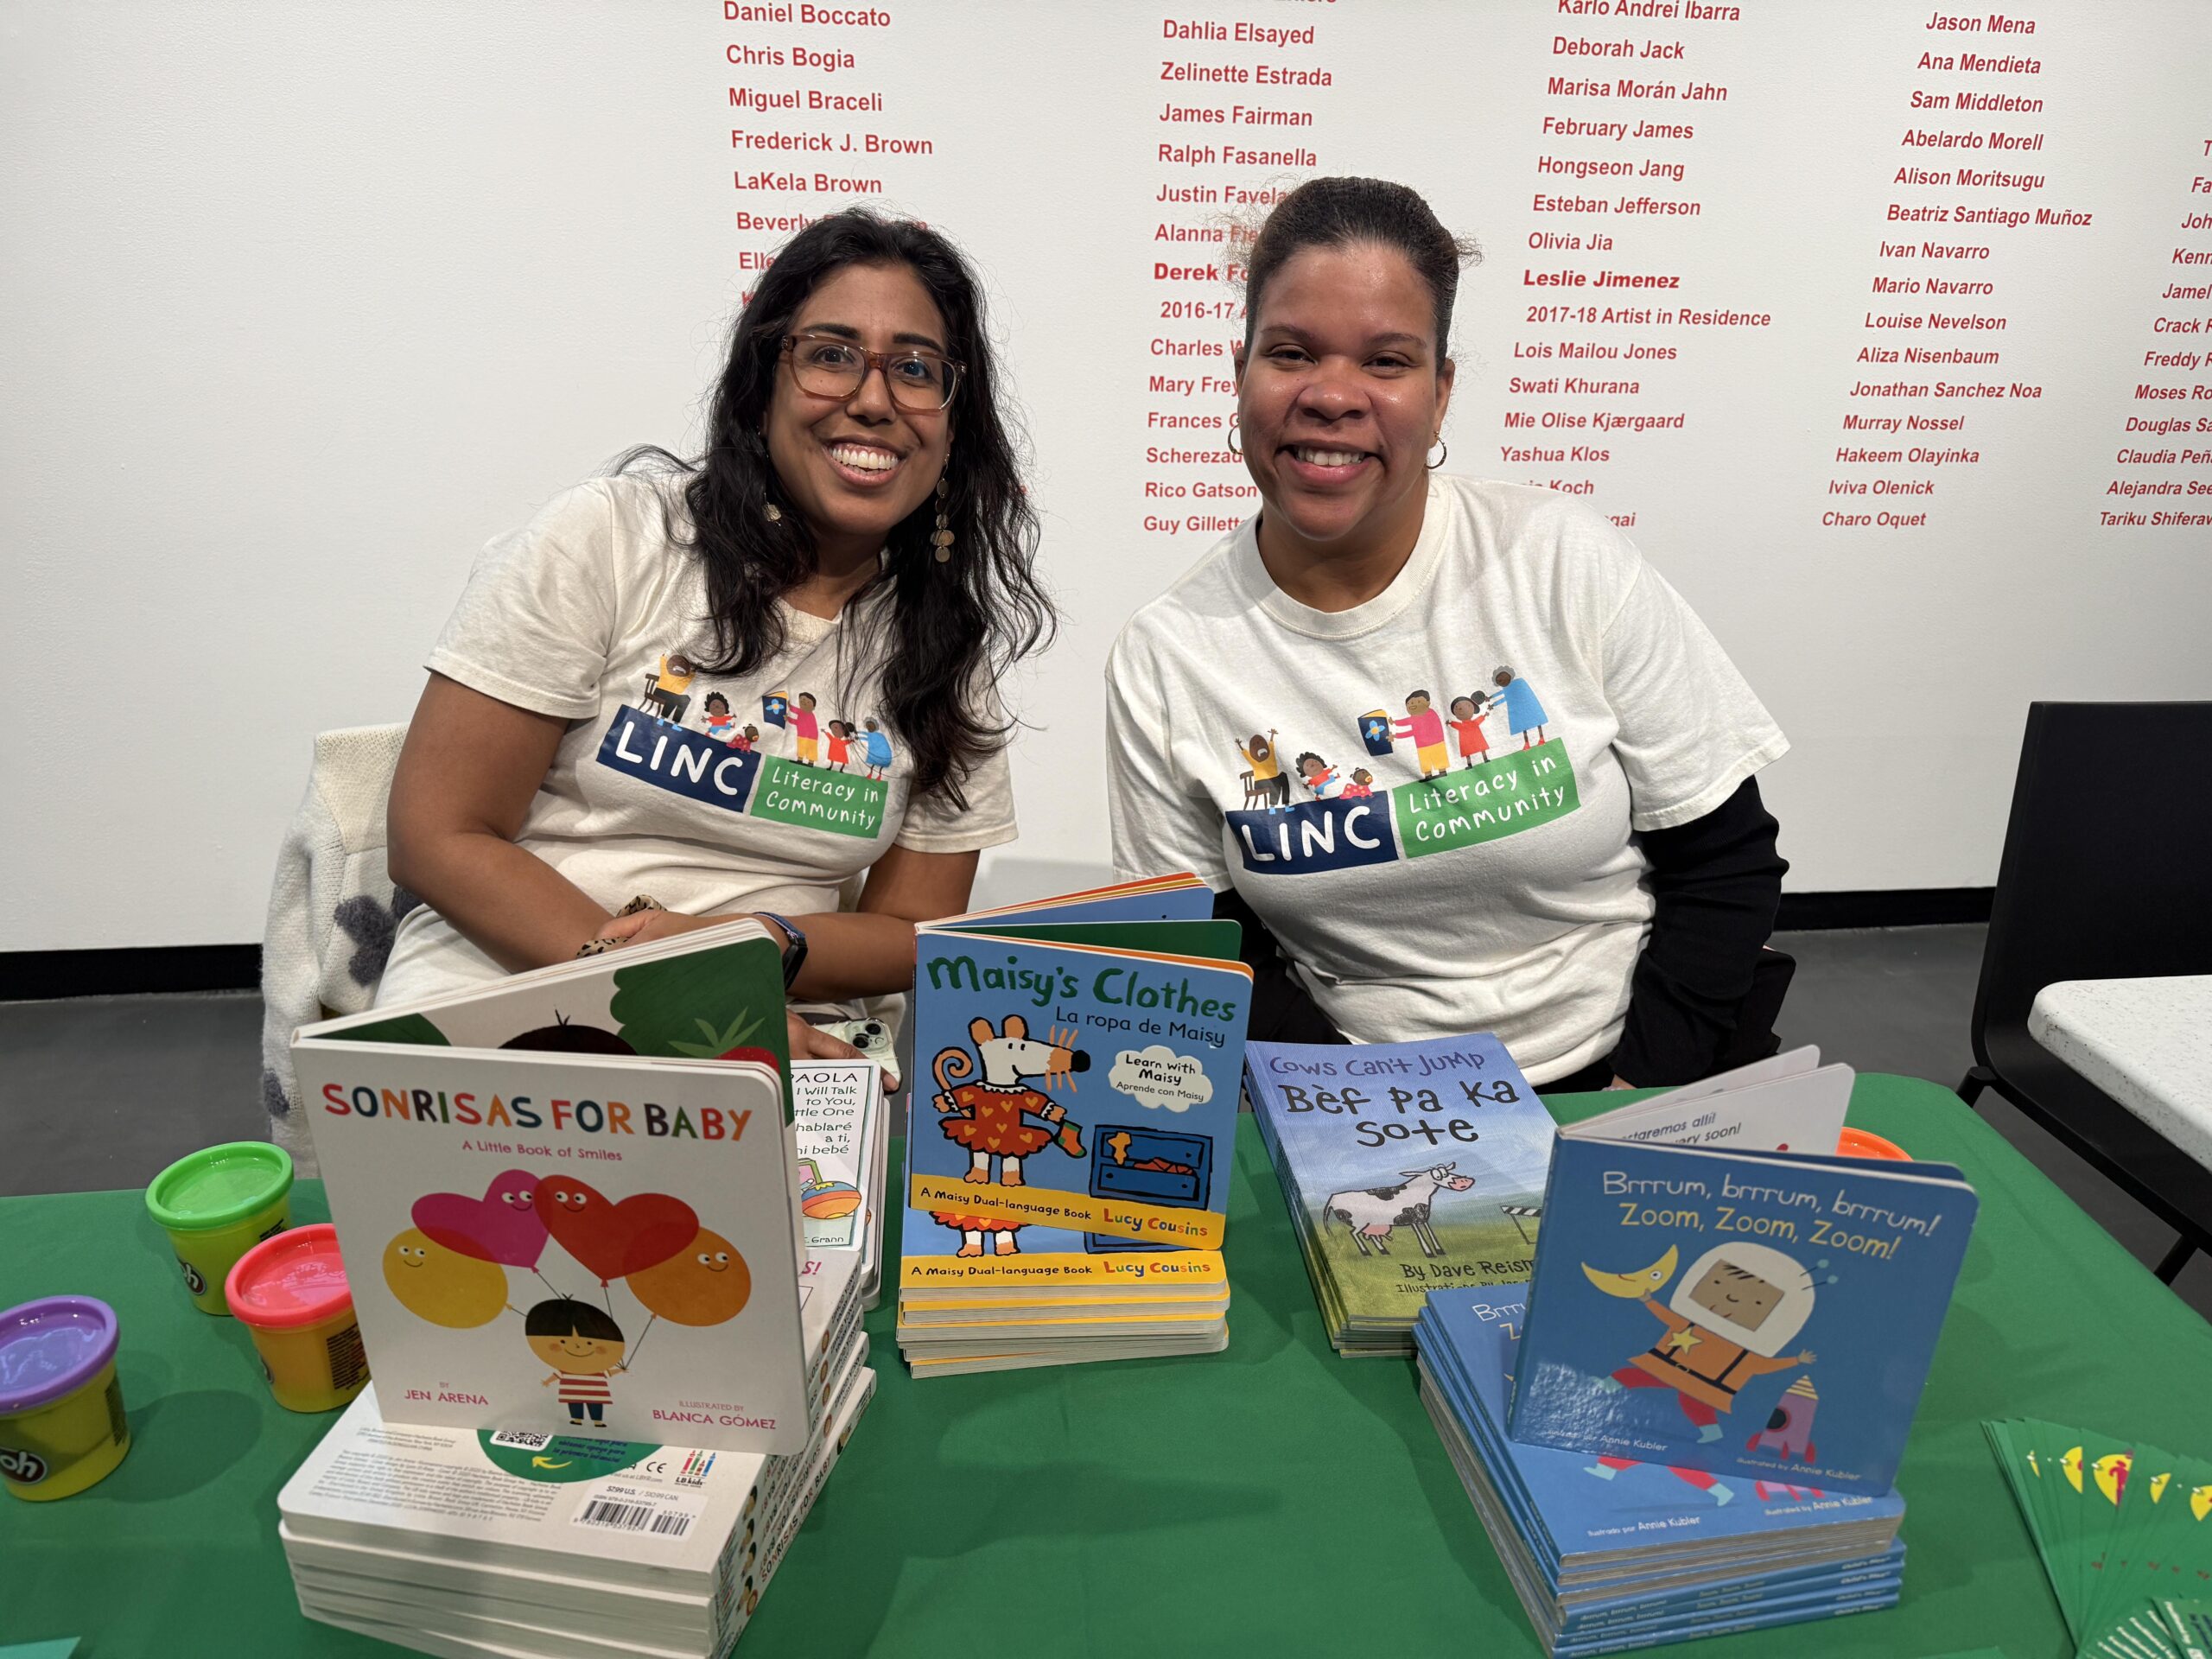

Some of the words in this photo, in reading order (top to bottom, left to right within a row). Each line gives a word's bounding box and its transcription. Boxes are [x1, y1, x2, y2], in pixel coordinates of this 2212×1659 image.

[724, 0, 792, 23] Daniel
[801, 3, 891, 28] Boccato
[1926, 13, 1981, 31] Jason
[1987, 15, 2036, 35] Mena
[1163, 19, 1228, 41] Dahlia
[1235, 22, 1314, 48] Elsayed
[726, 44, 785, 66] Chris
[792, 47, 855, 73] Bogia
[1553, 36, 1634, 57] Deborah
[1640, 41, 1685, 60] Jack
[1160, 61, 1249, 83] Zelinette
[1255, 65, 1332, 86] Estrada
[1917, 52, 1954, 70] Ana
[1960, 54, 2041, 74] Mendieta
[1548, 76, 1611, 97] Marisa
[1618, 79, 1676, 99] Morán
[1681, 83, 1727, 100] Jahn
[728, 86, 800, 113] Miguel
[808, 90, 882, 111] Braceli
[1910, 90, 1949, 109] Sam
[1955, 92, 2044, 112] Middleton
[1160, 103, 1225, 124] James
[1232, 105, 1313, 125] Fairman
[1543, 116, 1628, 142] February
[1633, 121, 1694, 139] James
[1901, 130, 1983, 149] Abelardo
[1989, 132, 2044, 150] Morell
[732, 129, 832, 151] Frederick
[840, 133, 857, 152] J.
[864, 134, 933, 155] Brown
[1159, 143, 1216, 166] Ralph
[1223, 145, 1317, 166] Fasanella
[1538, 156, 1634, 180] Hongseon
[1638, 160, 1685, 182] Jang
[1894, 168, 1951, 186] Alison
[1956, 168, 2044, 192] Moritsugu
[734, 171, 807, 192] LaKela
[814, 173, 882, 194] Brown
[1156, 184, 1217, 204] Justin
[1224, 186, 1290, 207] Favela
[1534, 194, 1609, 213] Esteban
[1614, 196, 1700, 215] Jefferson
[1887, 204, 1949, 222] Beatriz
[1954, 206, 2031, 228] Santiago
[2035, 207, 2092, 226] Muñoz
[1529, 232, 1580, 250] Olivia
[1586, 235, 1613, 251] Jia
[1880, 241, 1916, 257] Ivan
[1922, 242, 1990, 260] Navarro
[1523, 269, 1586, 288] Leslie
[1593, 270, 1680, 289] Jimenez
[1872, 276, 1921, 294] Mario
[1925, 278, 1994, 296] Navarro
[1526, 305, 1598, 324] 2017-18
[1600, 307, 1651, 325] Artist
[1657, 308, 1673, 324] in
[1679, 308, 1770, 327] Residence
[1866, 313, 1923, 329] Louise
[1929, 313, 2007, 330] Nevelson
[1514, 342, 1552, 359] Lois
[1559, 341, 1618, 359] Mailou
[1624, 345, 1677, 359] Jones
[1857, 346, 1899, 363] Aliza
[1904, 347, 1999, 365] Nisenbaum
[1149, 375, 1195, 397] Mary
[1510, 377, 1559, 394] Swati
[1564, 378, 1640, 395] Khurana
[1850, 381, 1929, 397] Jonathan
[1934, 382, 2005, 398] Sanchez
[2010, 383, 2042, 398] Noa
[1504, 411, 1535, 429] Mie
[1541, 411, 1587, 429] Olise
[1592, 412, 1685, 433] Kjærgaard
[1843, 415, 1902, 435] Murray
[1907, 416, 1964, 431] Nossel
[2125, 417, 2191, 435] Douglas
[1501, 446, 1565, 462] Yashua
[1571, 446, 1611, 461] Klos
[1835, 448, 1903, 463] Hakeem
[1908, 448, 1980, 467] Olayinka
[2117, 448, 2177, 464] Claudia
[1145, 481, 1187, 498] Rico
[1192, 481, 1258, 498] Gatson
[1829, 480, 1867, 495] Iviva
[1872, 480, 1935, 495] Olenick
[2107, 480, 2183, 498] Alejandra
[1821, 512, 1872, 525] Charo
[1876, 512, 1927, 529] Oquet
[2101, 512, 2146, 525] Tariku
[616, 721, 743, 796] LINC
[772, 766, 855, 799] Literacy
[864, 786, 879, 803] in
[1409, 770, 1518, 814] Literacy
[1532, 755, 1557, 778] in
[766, 791, 875, 830] Community
[1415, 785, 1565, 843] Community
[1241, 805, 1381, 861] LINC
[926, 956, 1078, 1007] Maisy's
[1092, 968, 1236, 1022] Clothes
[1056, 1007, 1078, 1024] La
[1086, 1014, 1131, 1033] ropa
[1139, 1018, 1161, 1035] de
[1169, 1022, 1225, 1048] Maisy
[1125, 1053, 1162, 1070] Learn
[1166, 1060, 1196, 1074] with
[1269, 1056, 1338, 1076] Cows
[1344, 1055, 1412, 1077] Can't
[1138, 1068, 1182, 1086] Maisy
[805, 1086, 828, 1095] Will
[830, 1086, 857, 1095] Talk
[1116, 1081, 1155, 1095] Aprende
[1157, 1087, 1174, 1096] con
[1177, 1089, 1205, 1103] Maisy
[1278, 1084, 1371, 1115] Bèf
[321, 1082, 542, 1128] SONRISAS
[550, 1098, 635, 1135] FOR
[645, 1103, 753, 1142] BABY
[823, 1108, 855, 1116] One
[825, 1097, 855, 1107] You,
[796, 1122, 852, 1132] hablaré
[461, 1141, 473, 1152] A
[477, 1141, 512, 1154] Little
[517, 1142, 552, 1158] Book
[557, 1147, 573, 1159] of
[577, 1148, 623, 1162] Smiles
[812, 1145, 849, 1155] bebé
[920, 1187, 931, 1198] A
[934, 1190, 969, 1205] Maisy
[974, 1195, 1060, 1217] Dual-language
[1064, 1208, 1091, 1221] Book
[1603, 1170, 1712, 1200] Brrrum,
[1721, 1173, 1821, 1213] brrrum,
[1831, 1190, 1942, 1237] brrrum!
[1103, 1208, 1143, 1232] Lucy
[1147, 1217, 1208, 1236] Cousins
[1618, 1202, 1705, 1233] Zoom,
[1714, 1206, 1798, 1243] Zoom,
[1808, 1220, 1903, 1260] Zoom!
[404, 1389, 432, 1402] JEN
[437, 1391, 489, 1406] ARENA
[652, 1409, 711, 1425] BLANCA
[721, 1414, 777, 1430] GÓMEZ
